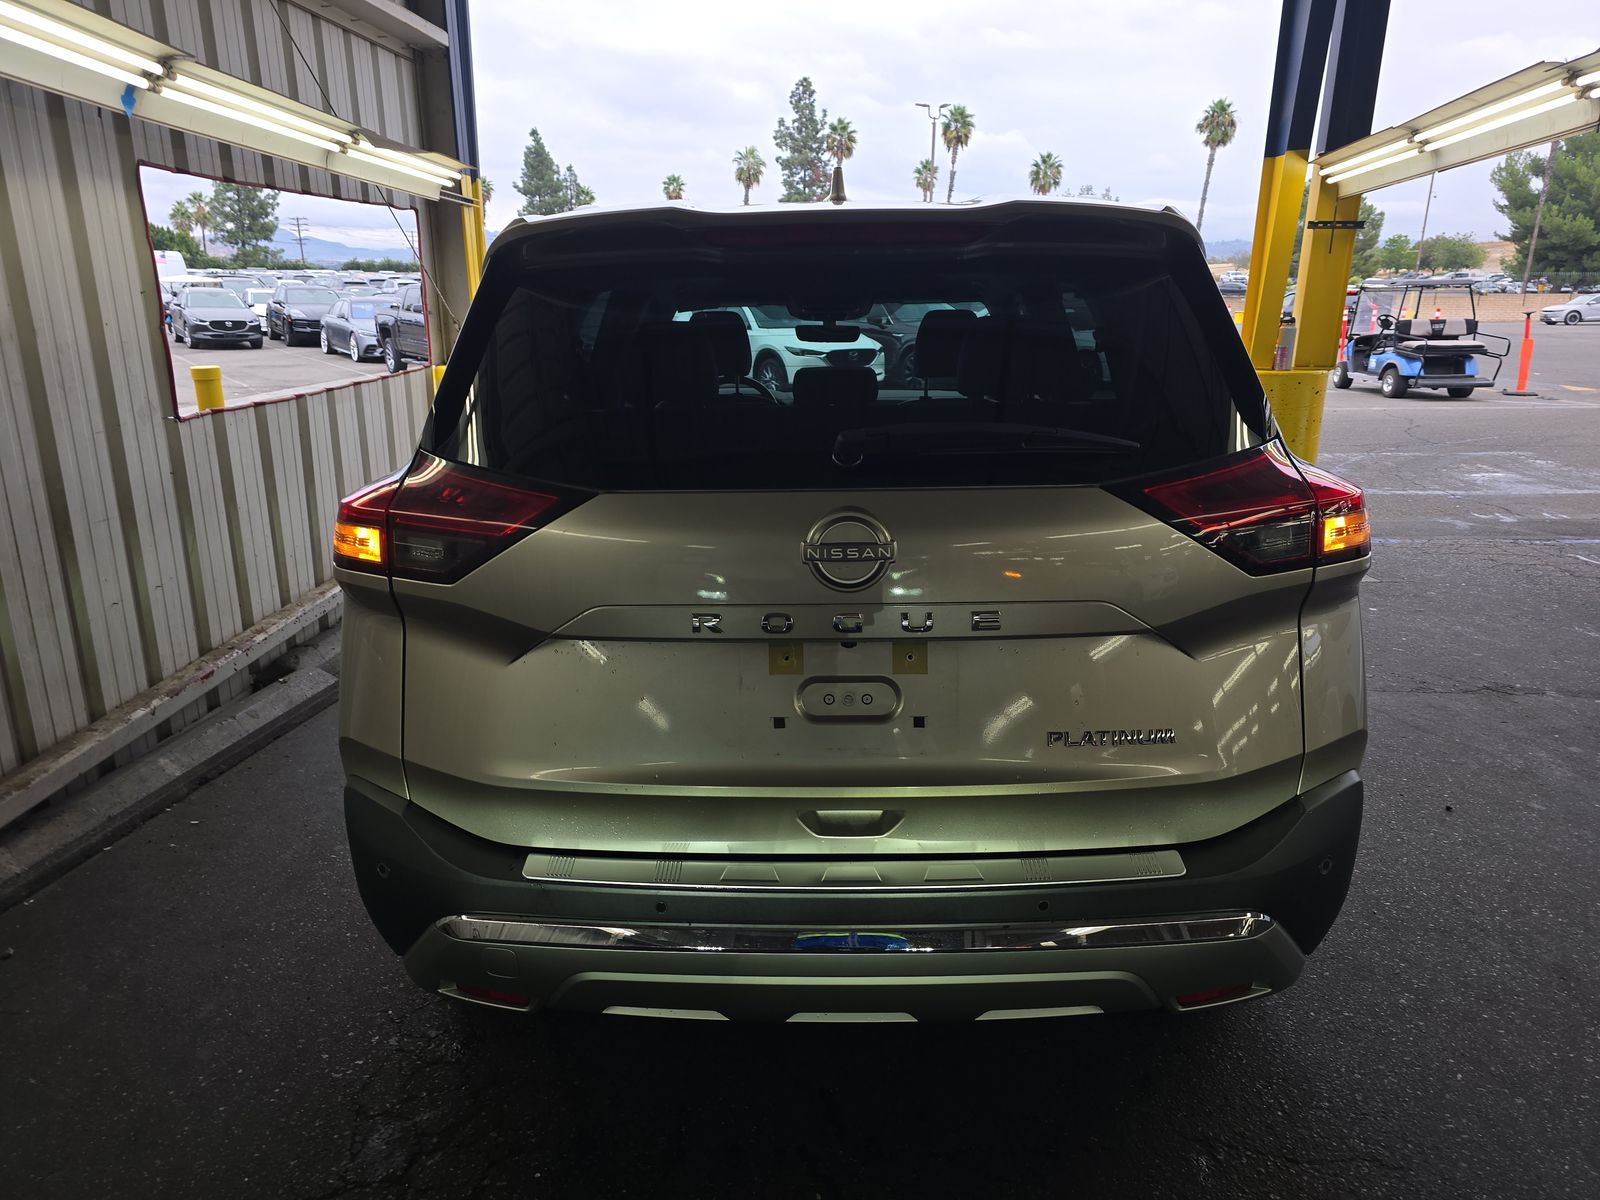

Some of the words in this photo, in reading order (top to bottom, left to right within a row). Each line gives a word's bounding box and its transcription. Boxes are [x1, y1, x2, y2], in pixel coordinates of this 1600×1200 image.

[807, 546, 892, 560] NISSAN
[691, 611, 1001, 634] ROGUE
[1046, 728, 1177, 747] PLATINUM
